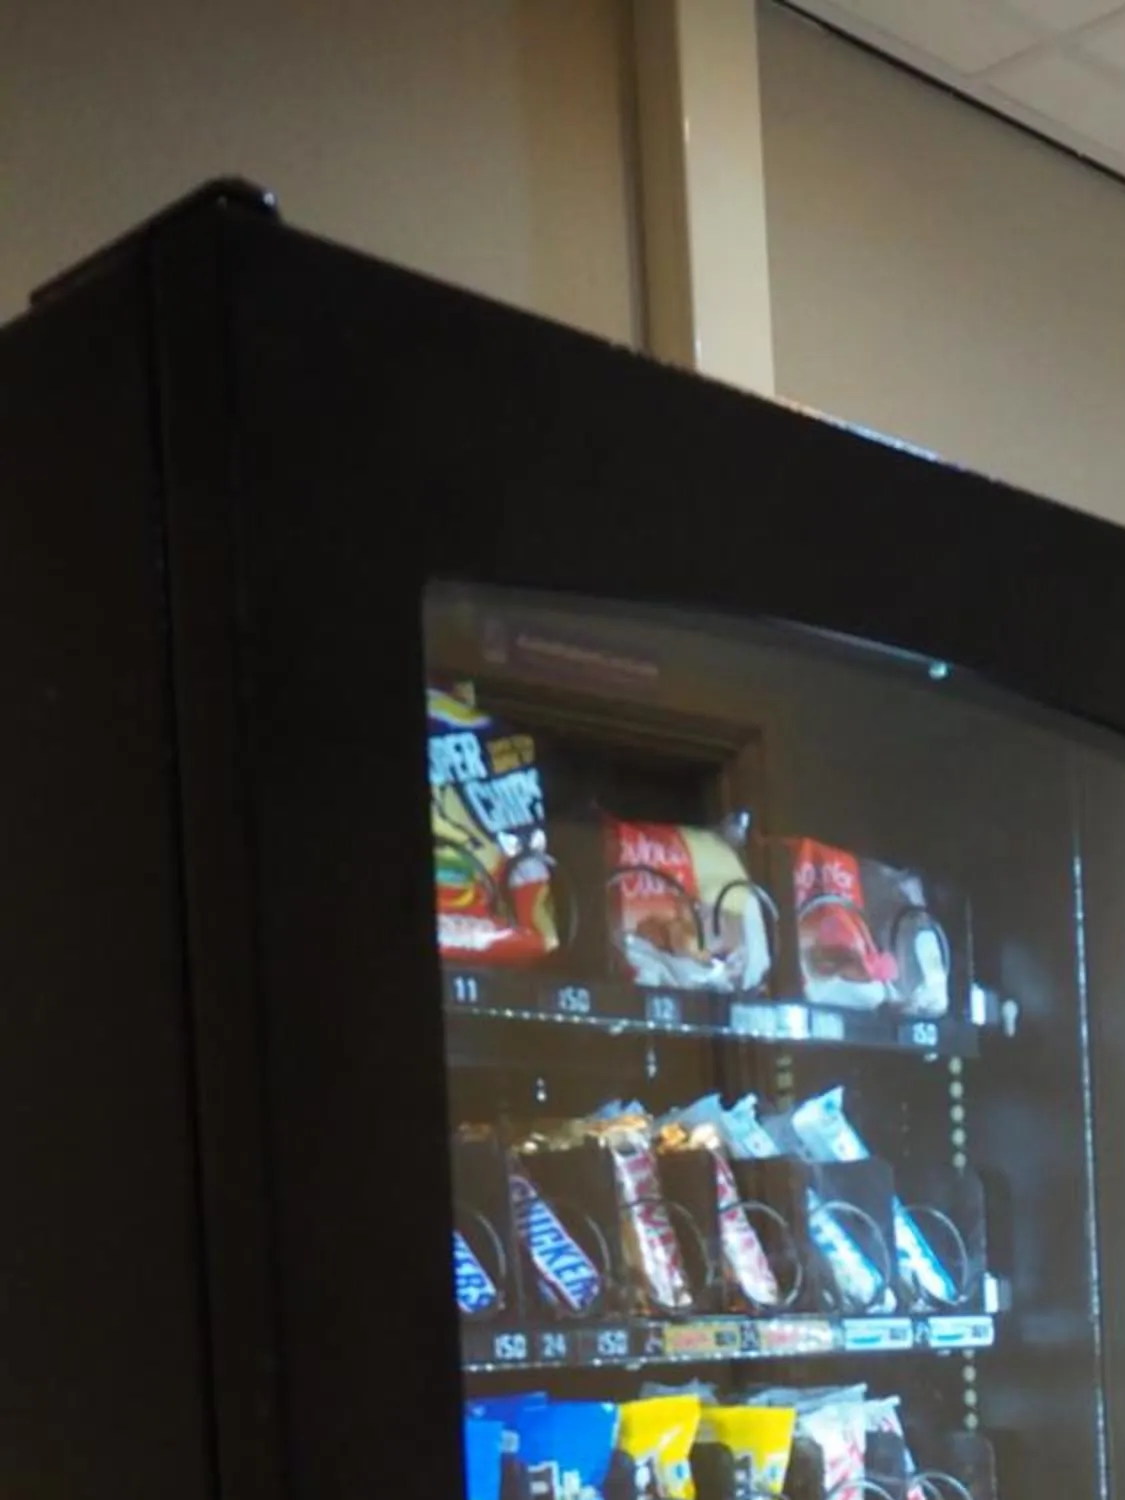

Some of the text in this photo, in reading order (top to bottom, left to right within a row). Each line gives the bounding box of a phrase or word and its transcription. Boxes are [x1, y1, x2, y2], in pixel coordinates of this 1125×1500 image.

[454, 976, 478, 1002] 11
[494, 1333, 528, 1359] 150
[542, 1332, 567, 1358] 24
[597, 1330, 628, 1356] 150
